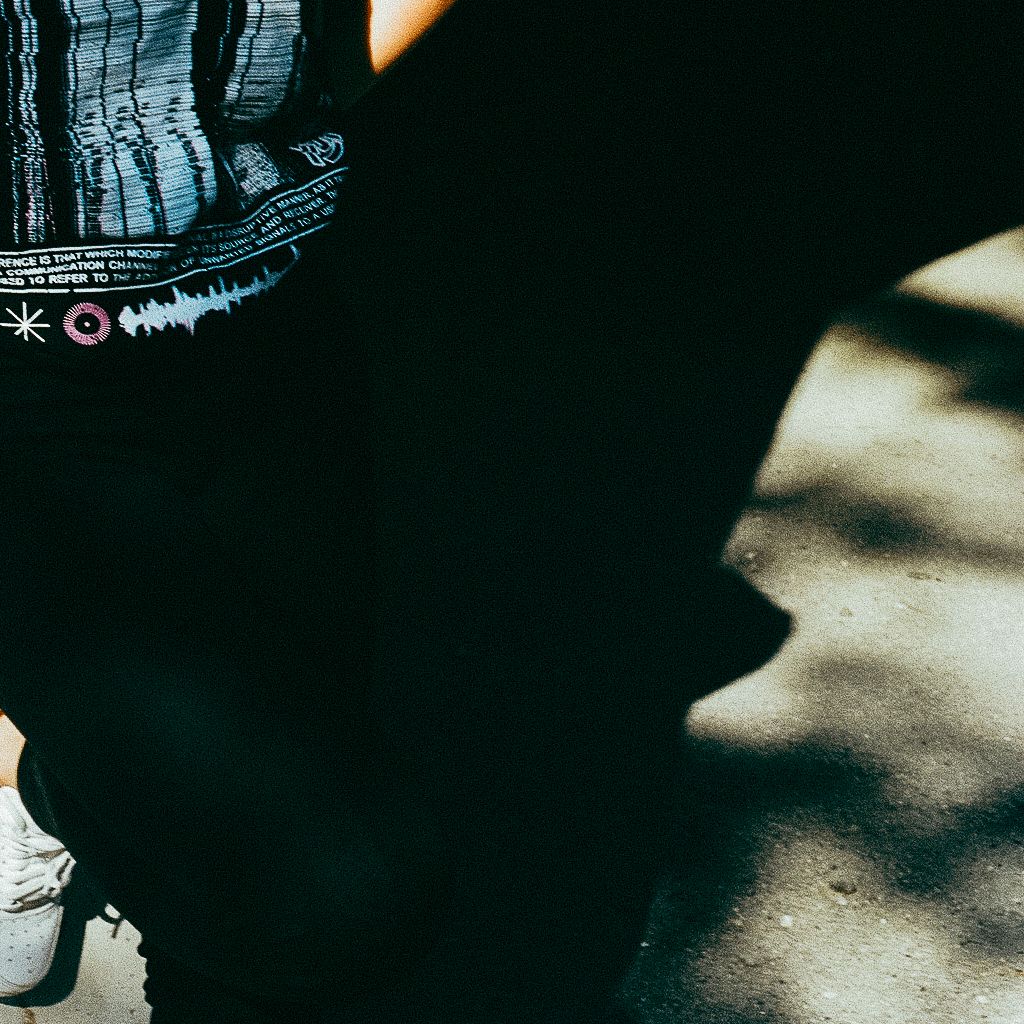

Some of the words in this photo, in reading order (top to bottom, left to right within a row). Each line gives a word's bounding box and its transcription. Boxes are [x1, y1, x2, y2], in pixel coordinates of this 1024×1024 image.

[5, 260, 105, 276] COMMUNICATION
[260, 215, 282, 234] AND
[39, 255, 51, 265] IS
[53, 252, 83, 263] THAT
[85, 249, 124, 259] WHICH
[28, 275, 45, 285] TO
[48, 273, 89, 284] REFER
[92, 273, 109, 283] TO
